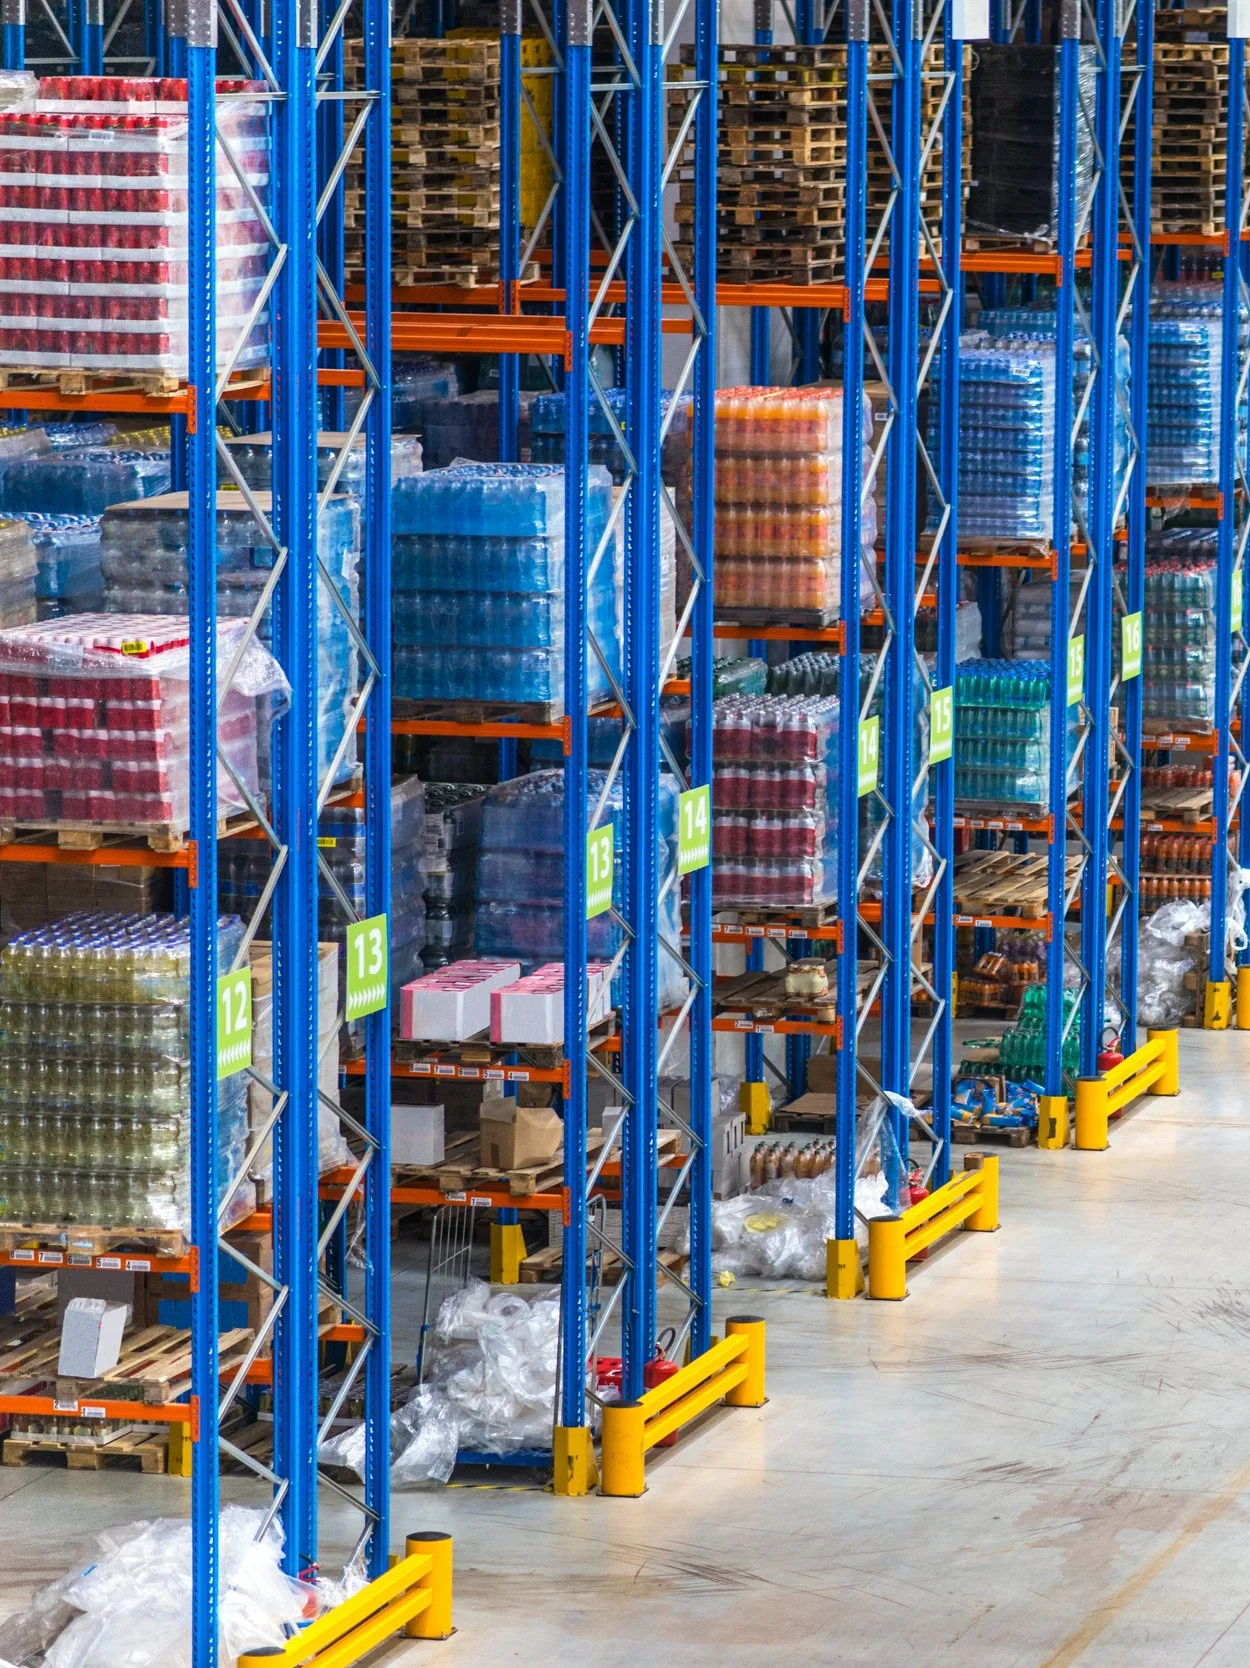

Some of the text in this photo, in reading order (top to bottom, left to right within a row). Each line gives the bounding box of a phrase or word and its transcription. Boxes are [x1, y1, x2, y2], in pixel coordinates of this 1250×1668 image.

[1126, 620, 1140, 654] 16
[1070, 644, 1083, 679] 15
[934, 696, 951, 734] 15
[861, 725, 877, 765] 14
[684, 795, 707, 840] 14
[590, 836, 610, 882] 13
[354, 928, 383, 979] 13
[222, 980, 248, 1036] 12
